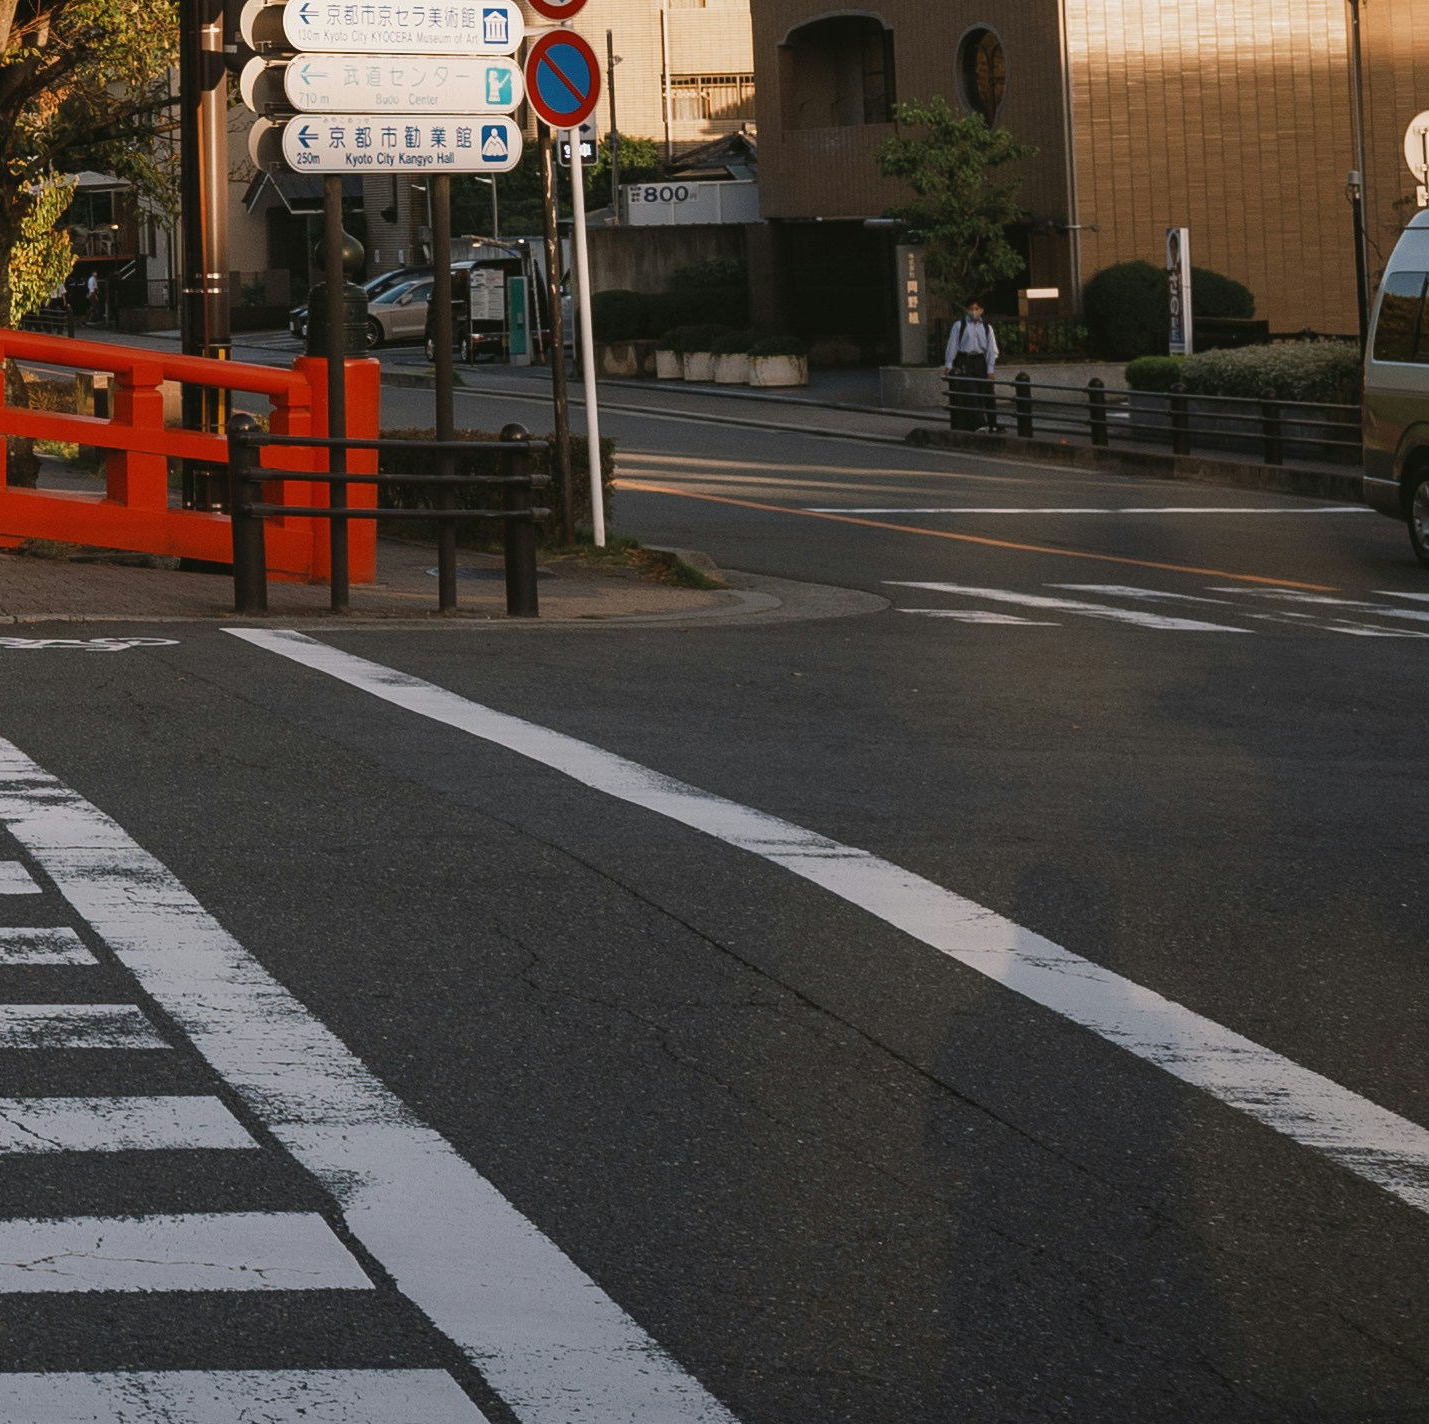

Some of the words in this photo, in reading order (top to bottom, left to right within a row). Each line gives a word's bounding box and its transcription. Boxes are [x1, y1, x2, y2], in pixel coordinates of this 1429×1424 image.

[326, 4, 476, 29] 京都市京セラ美術館
[297, 29, 321, 42] 130m
[323, 30, 348, 44] Kyoto
[351, 31, 368, 45] City
[370, 31, 413, 43] KYOCERA
[416, 32, 452, 45] Museum
[453, 33, 463, 45] of
[465, 33, 479, 45] Art
[343, 64, 471, 87] 武道センター
[375, 94, 399, 105] Budo
[408, 94, 439, 106] Center
[328, 125, 472, 149] 京都市勧業館
[297, 153, 321, 165] 250m
[345, 153, 373, 167] Kyoto
[376, 153, 395, 167] City
[398, 153, 434, 167] Kangyo
[437, 152, 455, 164] Hall
[644, 185, 689, 203] 800
